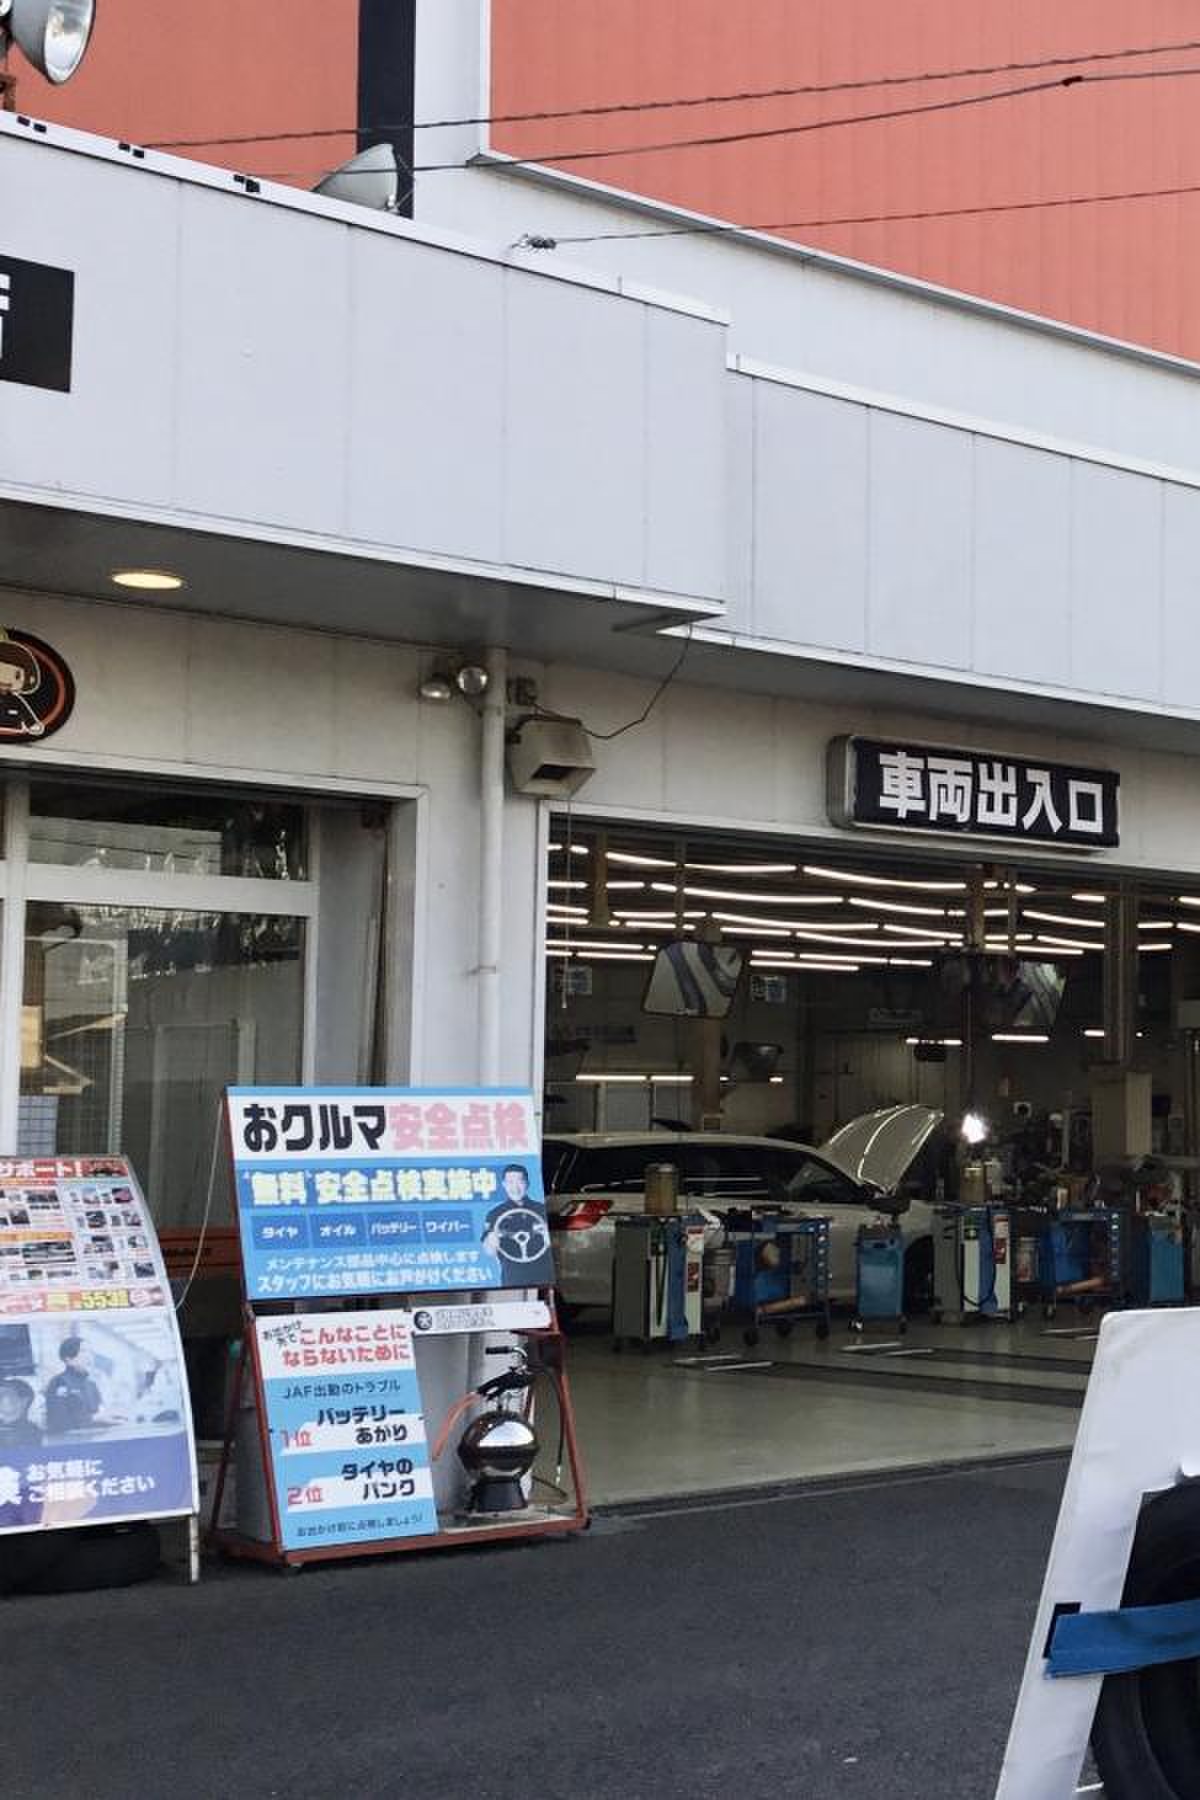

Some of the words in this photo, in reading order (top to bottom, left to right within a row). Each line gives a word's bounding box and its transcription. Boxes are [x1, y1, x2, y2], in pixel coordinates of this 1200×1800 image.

[880, 752, 1103, 832] 車両出入口
[244, 1104, 528, 1152] おクルマ安全点検
[300, 1324, 407, 1345] こんなことに
[282, 1344, 411, 1368] ならないために
[317, 1405, 406, 1426] バッテリー
[341, 1458, 414, 1481] タイヤの
